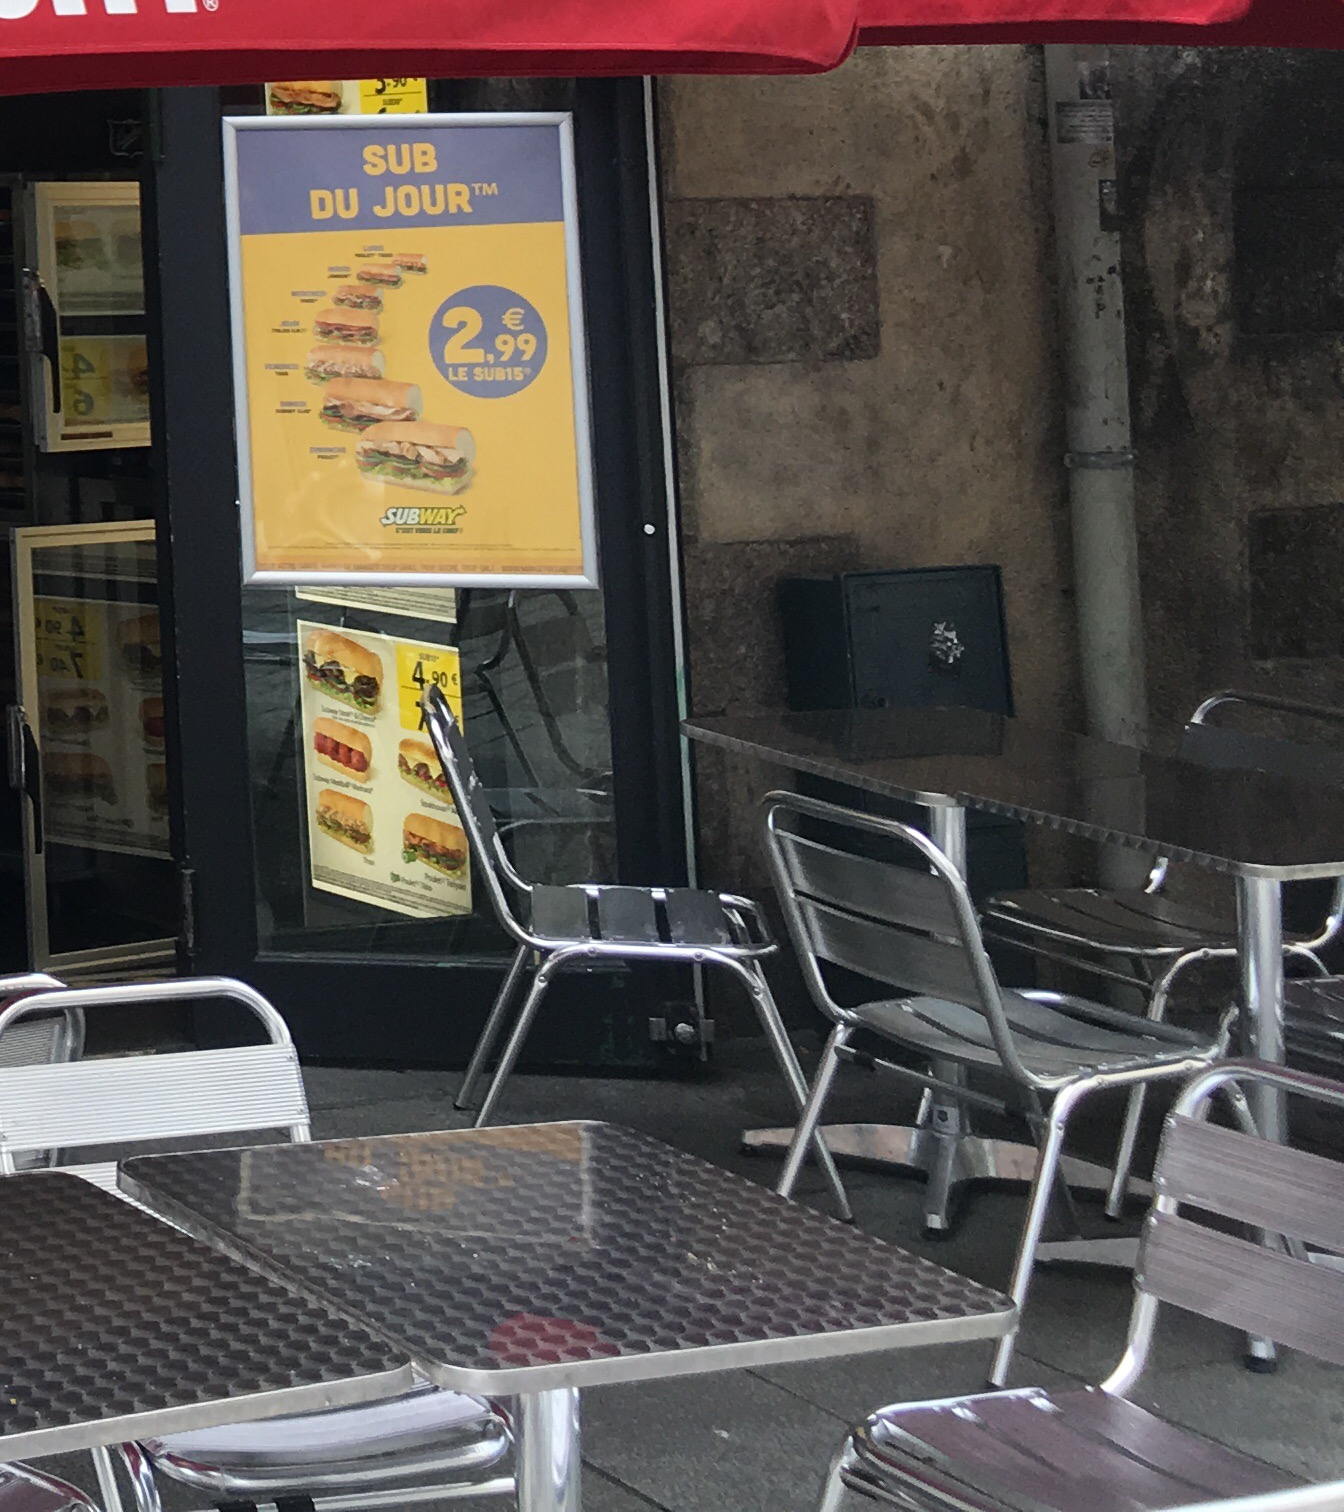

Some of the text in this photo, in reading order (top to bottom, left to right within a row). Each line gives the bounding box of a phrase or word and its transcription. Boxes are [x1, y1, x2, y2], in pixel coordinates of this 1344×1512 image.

[362, 142, 439, 177] SUB
[309, 188, 359, 220] DU
[502, 307, 525, 331] €
[448, 367, 469, 381] LE
[379, 504, 468, 528] SUBWAY
